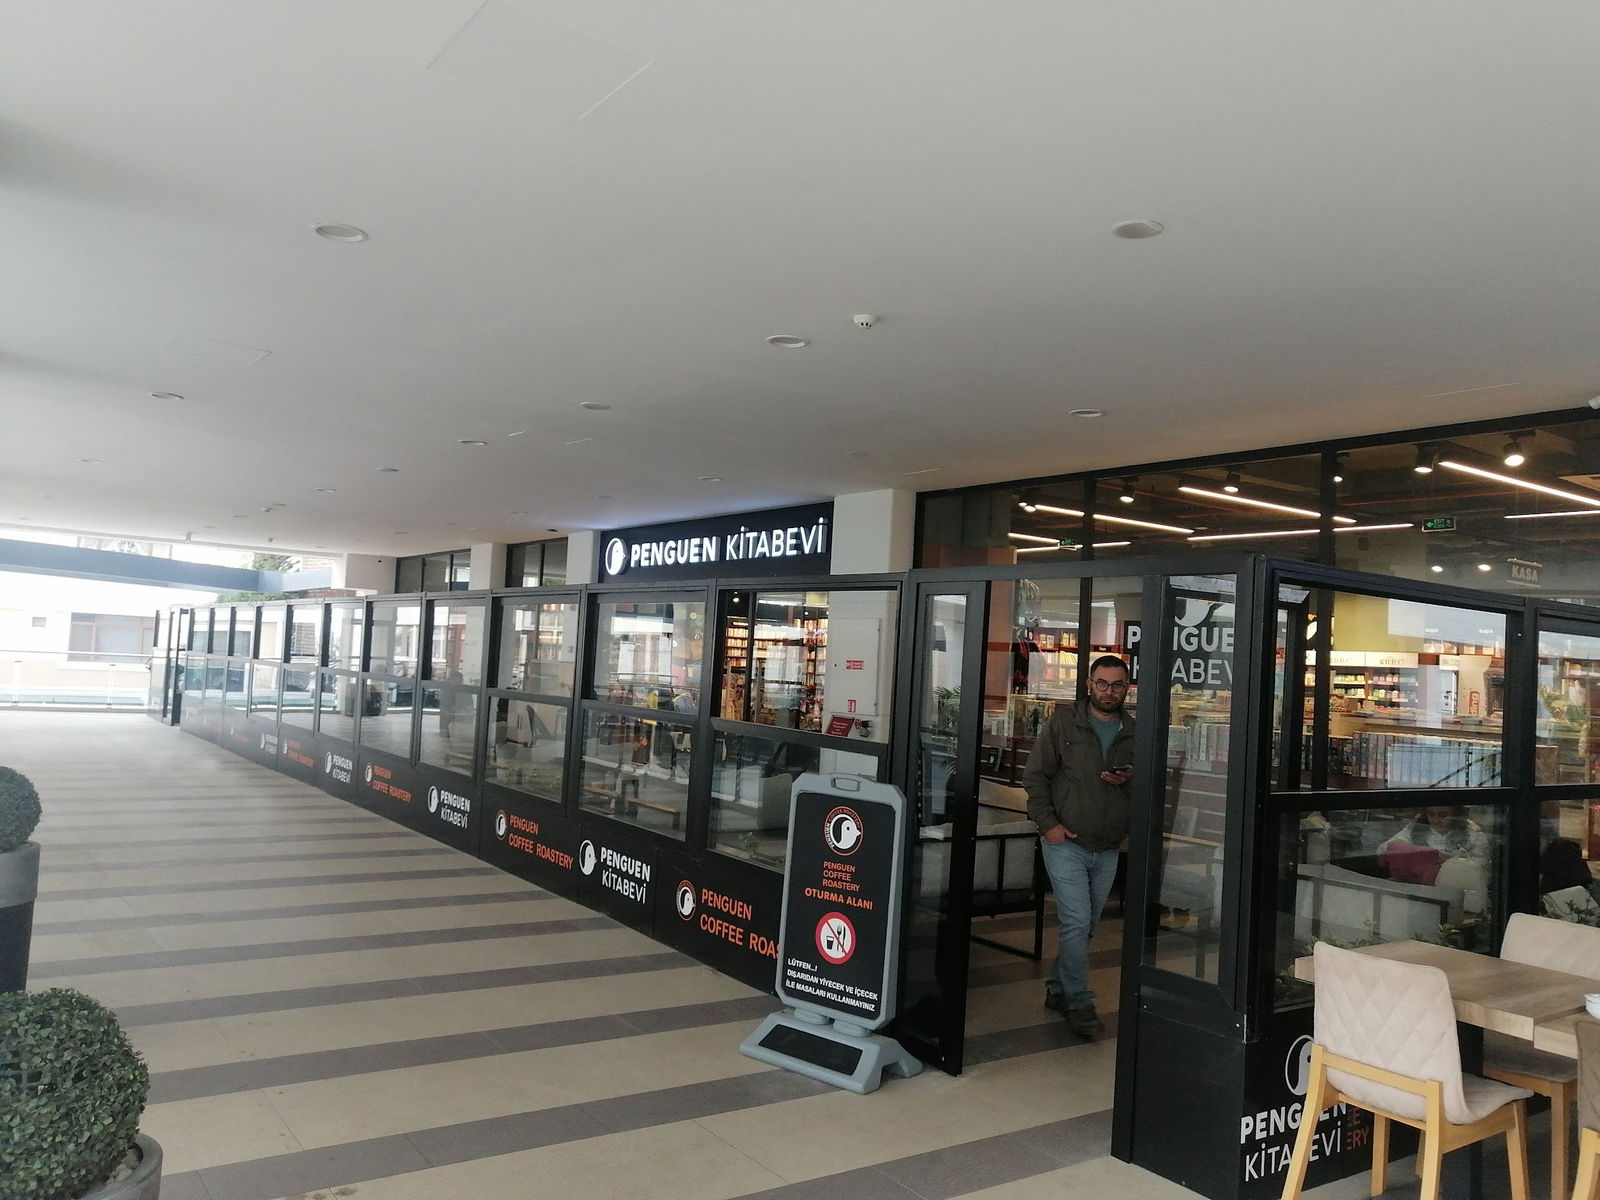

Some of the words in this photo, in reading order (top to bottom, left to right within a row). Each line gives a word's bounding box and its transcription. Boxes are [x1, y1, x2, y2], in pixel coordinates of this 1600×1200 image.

[630, 535, 718, 568] PENGUEN
[725, 516, 825, 561] KİTABEVİ
[1511, 564, 1538, 582] KASA
[332, 754, 353, 771] PENGUEN
[440, 790, 471, 813] PENGUEN
[440, 806, 468, 829] KİTABEVİ
[509, 814, 539, 836] PENGUEN
[508, 833, 534, 854] COFFEE
[536, 843, 574, 870] ROASTERY
[600, 846, 651, 882] PENGUEN
[823, 861, 856, 873] PENGUEN
[823, 870, 852, 881] COFFEE
[601, 867, 646, 905] KİTABEVİ
[804, 887, 844, 903] OTURMA
[822, 878, 861, 892] ROASTERY
[701, 887, 752, 921] PENGUEN
[700, 913, 744, 946] COFFEE
[785, 978, 796, 989] İLE
[796, 982, 826, 998] MASALARI
[826, 990, 876, 1012] KULLANMAYINIZ
[787, 969, 819, 984] DIŞARIDAN
[819, 977, 845, 992] YİYECEK
[845, 985, 854, 994] VE
[854, 986, 878, 1001] İÇECEK
[1244, 1120, 1342, 1182] KİTAEVİ
